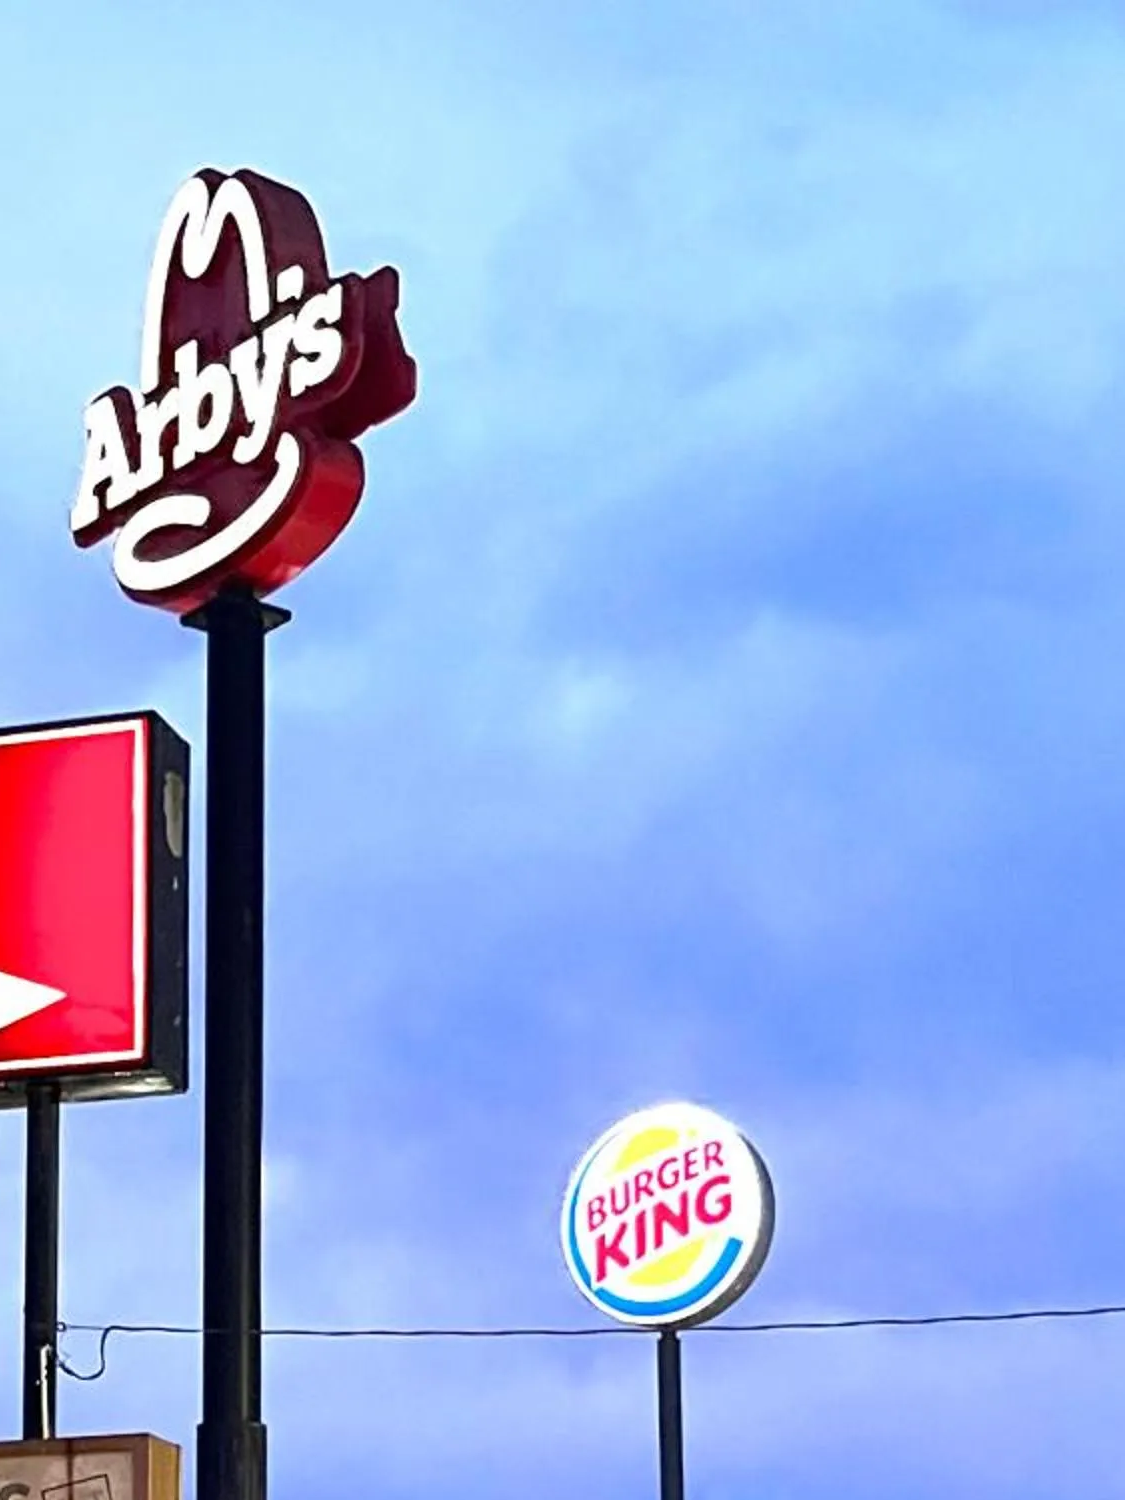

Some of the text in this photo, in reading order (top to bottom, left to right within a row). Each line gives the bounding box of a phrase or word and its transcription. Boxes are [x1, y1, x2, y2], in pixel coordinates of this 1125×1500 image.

[71, 265, 342, 532] Arby's
[586, 1139, 725, 1233] BURGER
[595, 1174, 733, 1283] KING
